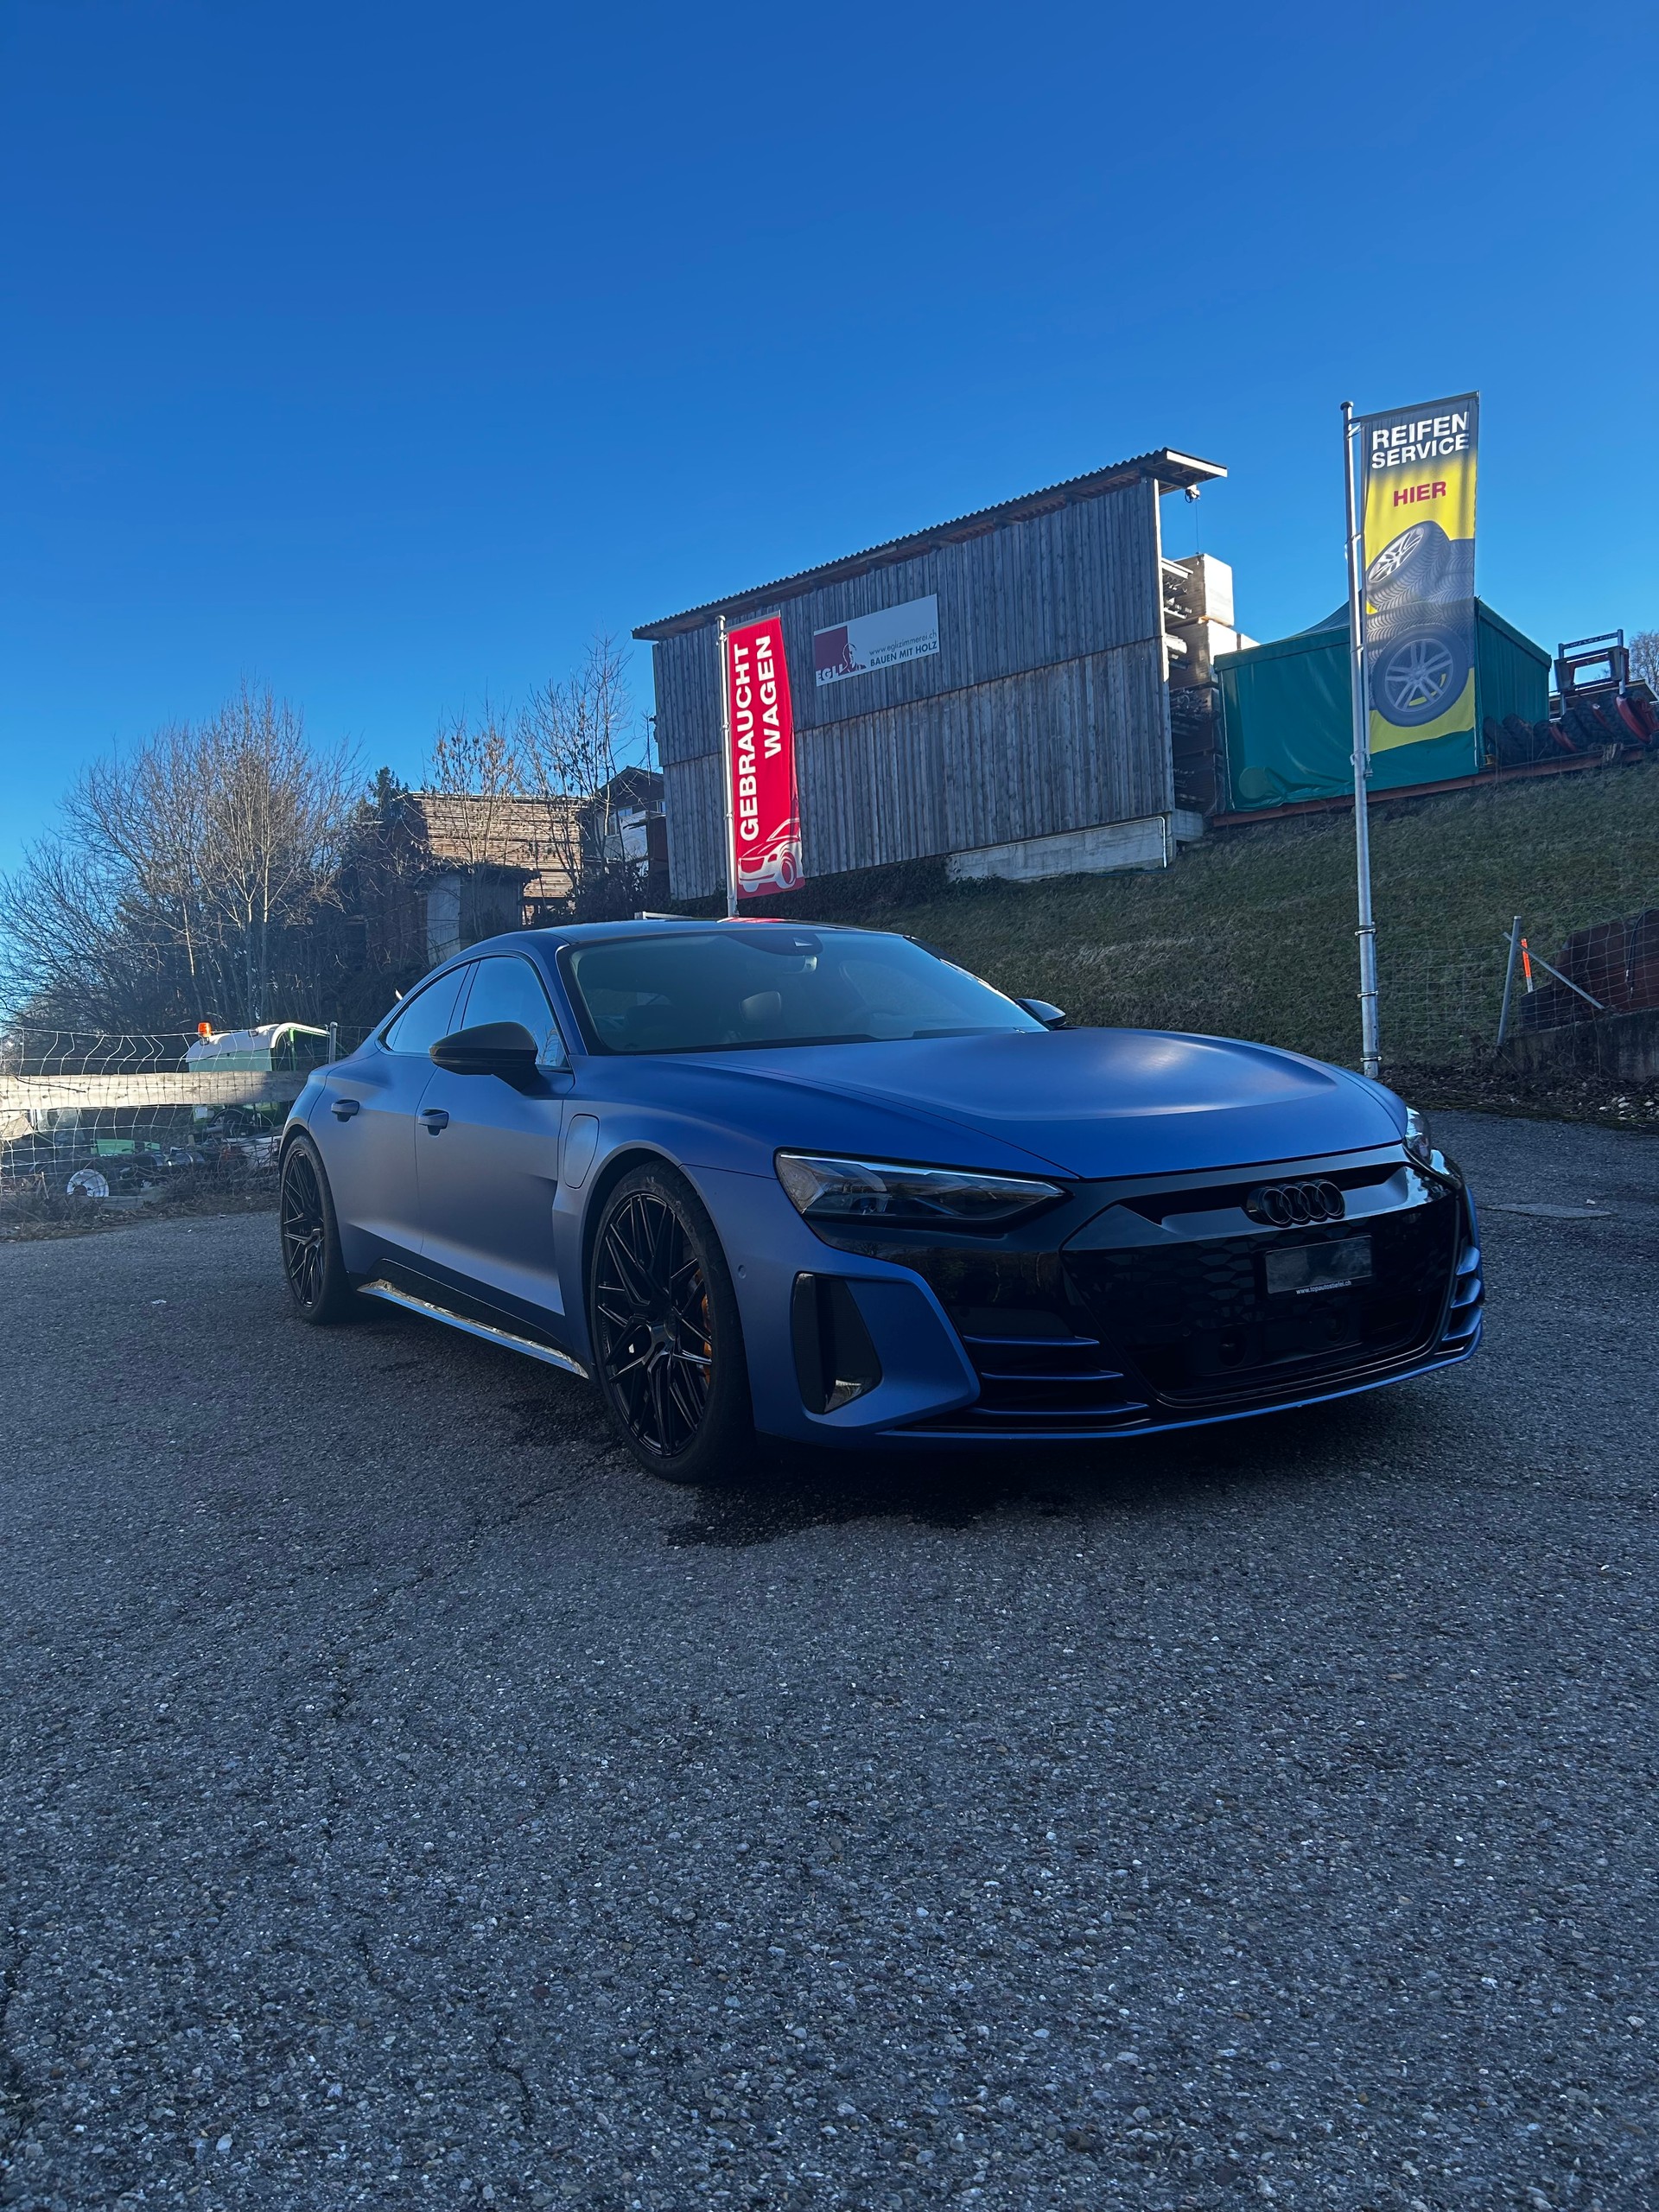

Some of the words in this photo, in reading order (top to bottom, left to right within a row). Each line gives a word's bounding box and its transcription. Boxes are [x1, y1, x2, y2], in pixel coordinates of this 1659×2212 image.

[1372, 411, 1469, 450] REIFEN
[1371, 433, 1469, 469] SERVICE
[1393, 480, 1447, 507] HIER
[869, 629, 938, 656] www.eglizimmerei.ch
[870, 652, 897, 667] BAUEN
[899, 647, 913, 659] MIT
[916, 640, 938, 654] HOLZ
[755, 635, 782, 759] WAGEN
[734, 644, 760, 842] GEBRAUCHT
